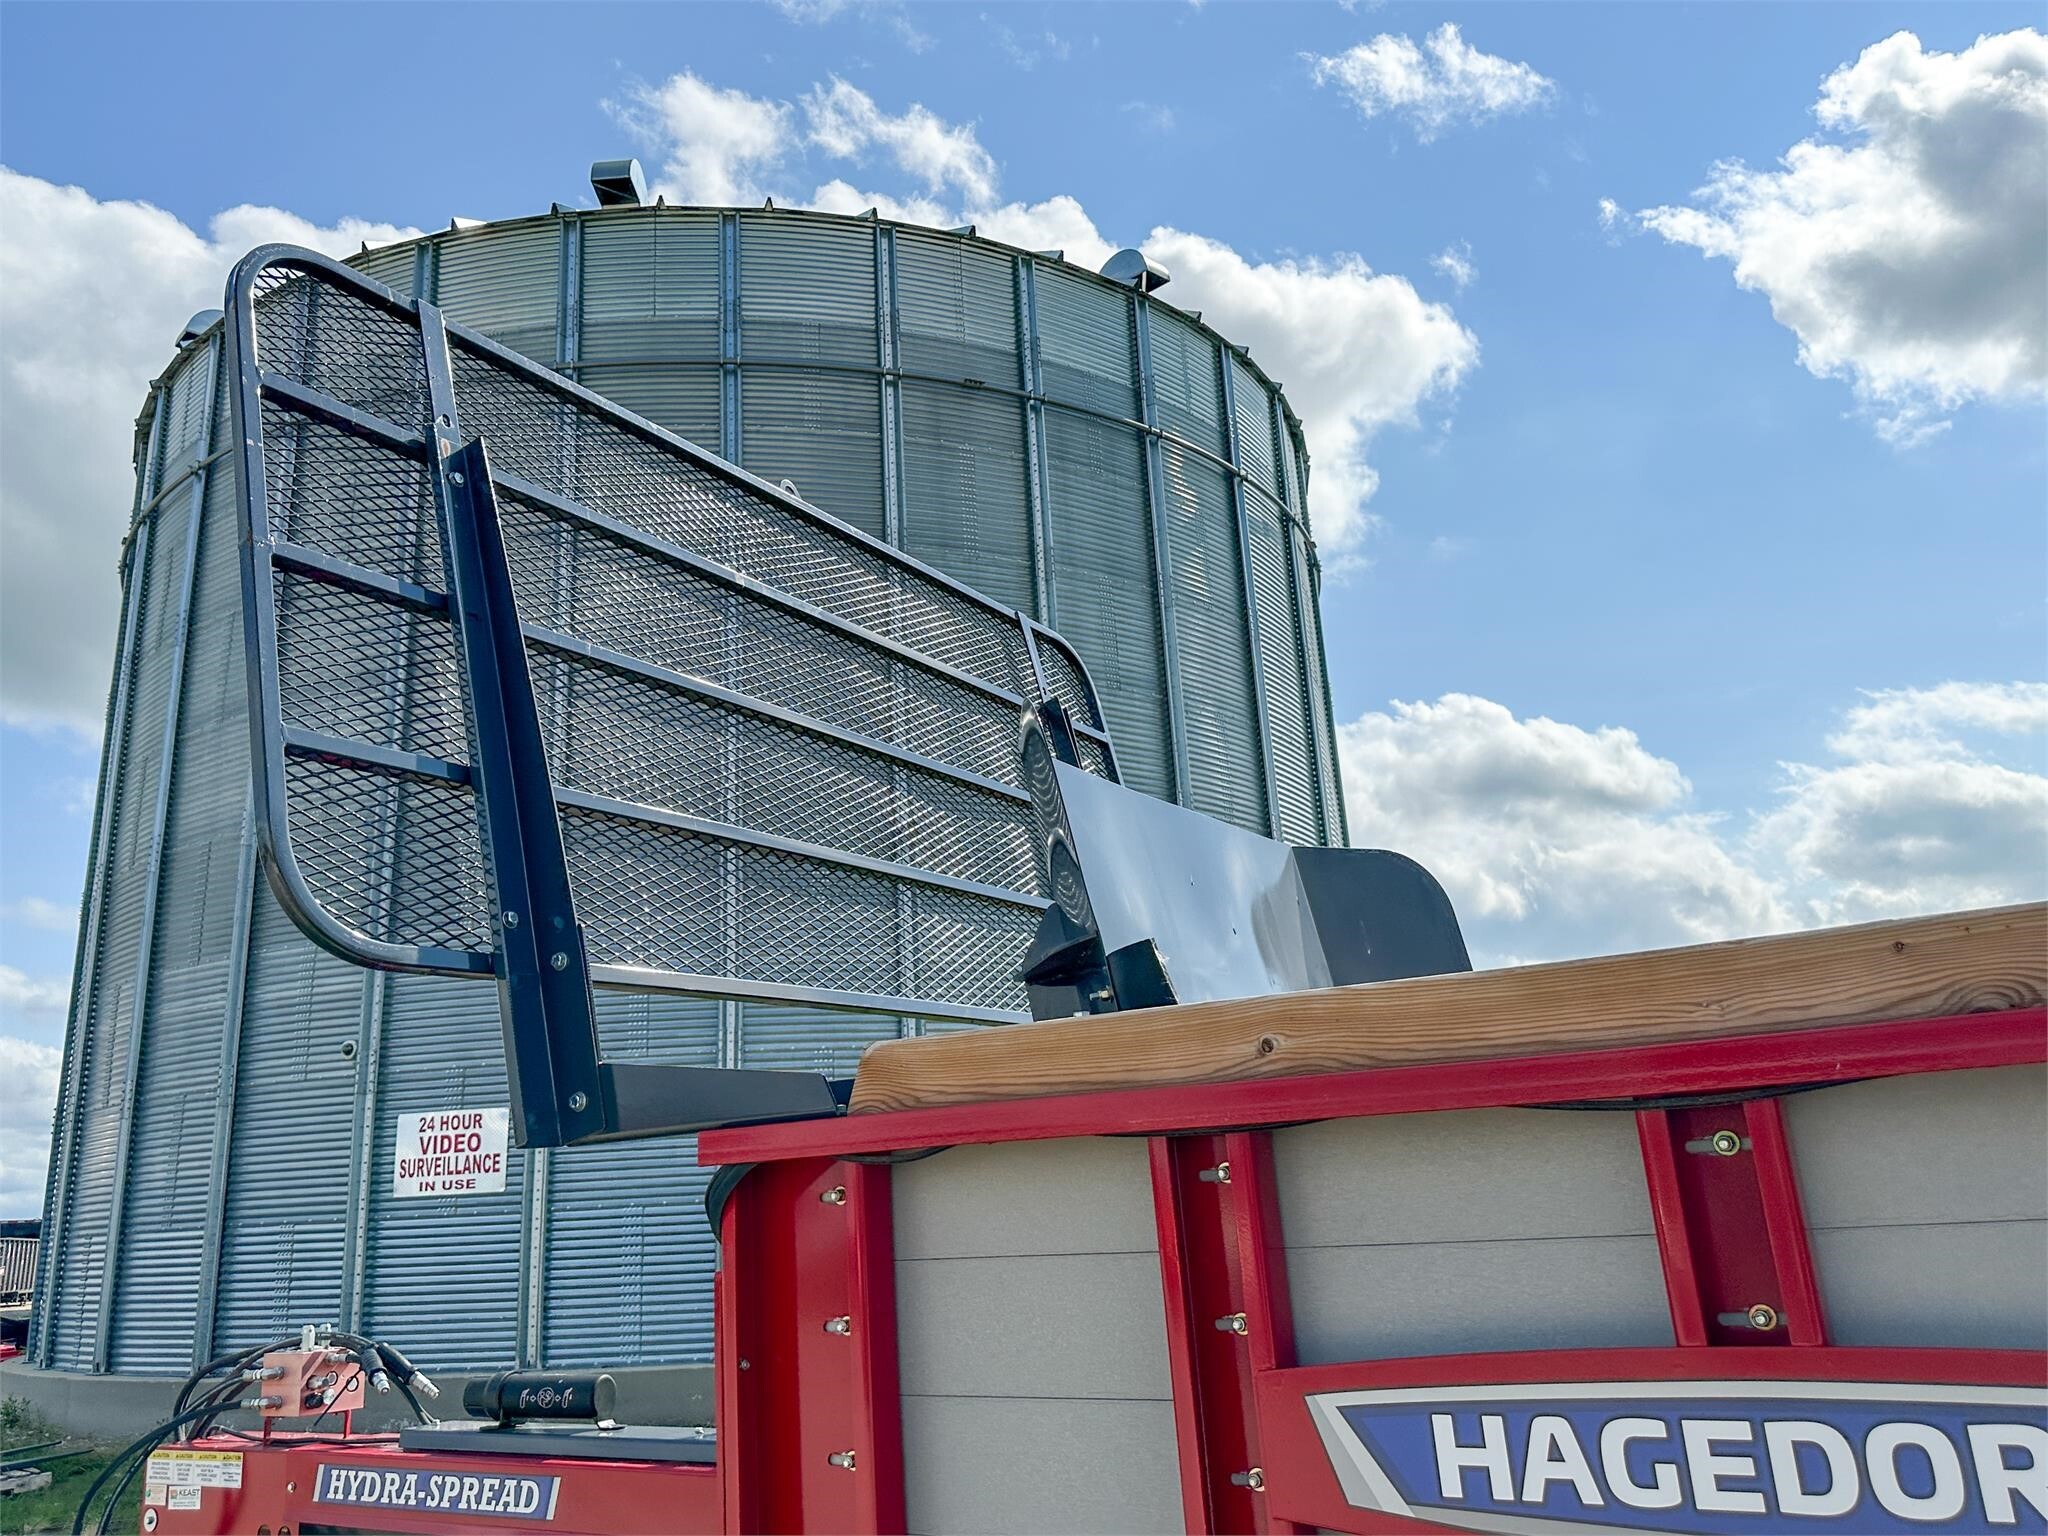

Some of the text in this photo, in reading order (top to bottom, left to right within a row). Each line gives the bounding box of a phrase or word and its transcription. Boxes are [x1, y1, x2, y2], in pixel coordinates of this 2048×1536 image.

[419, 1113, 483, 1133] 24 HOUR
[419, 1132, 481, 1155] VIDEO
[399, 1153, 501, 1179] SURVEILLANCE
[419, 1178, 477, 1192] IN USE
[1430, 1413, 2048, 1524] HAGEDOR
[178, 1489, 200, 1497] KEAST
[326, 1469, 540, 1514] HYDRA-SPREAD
